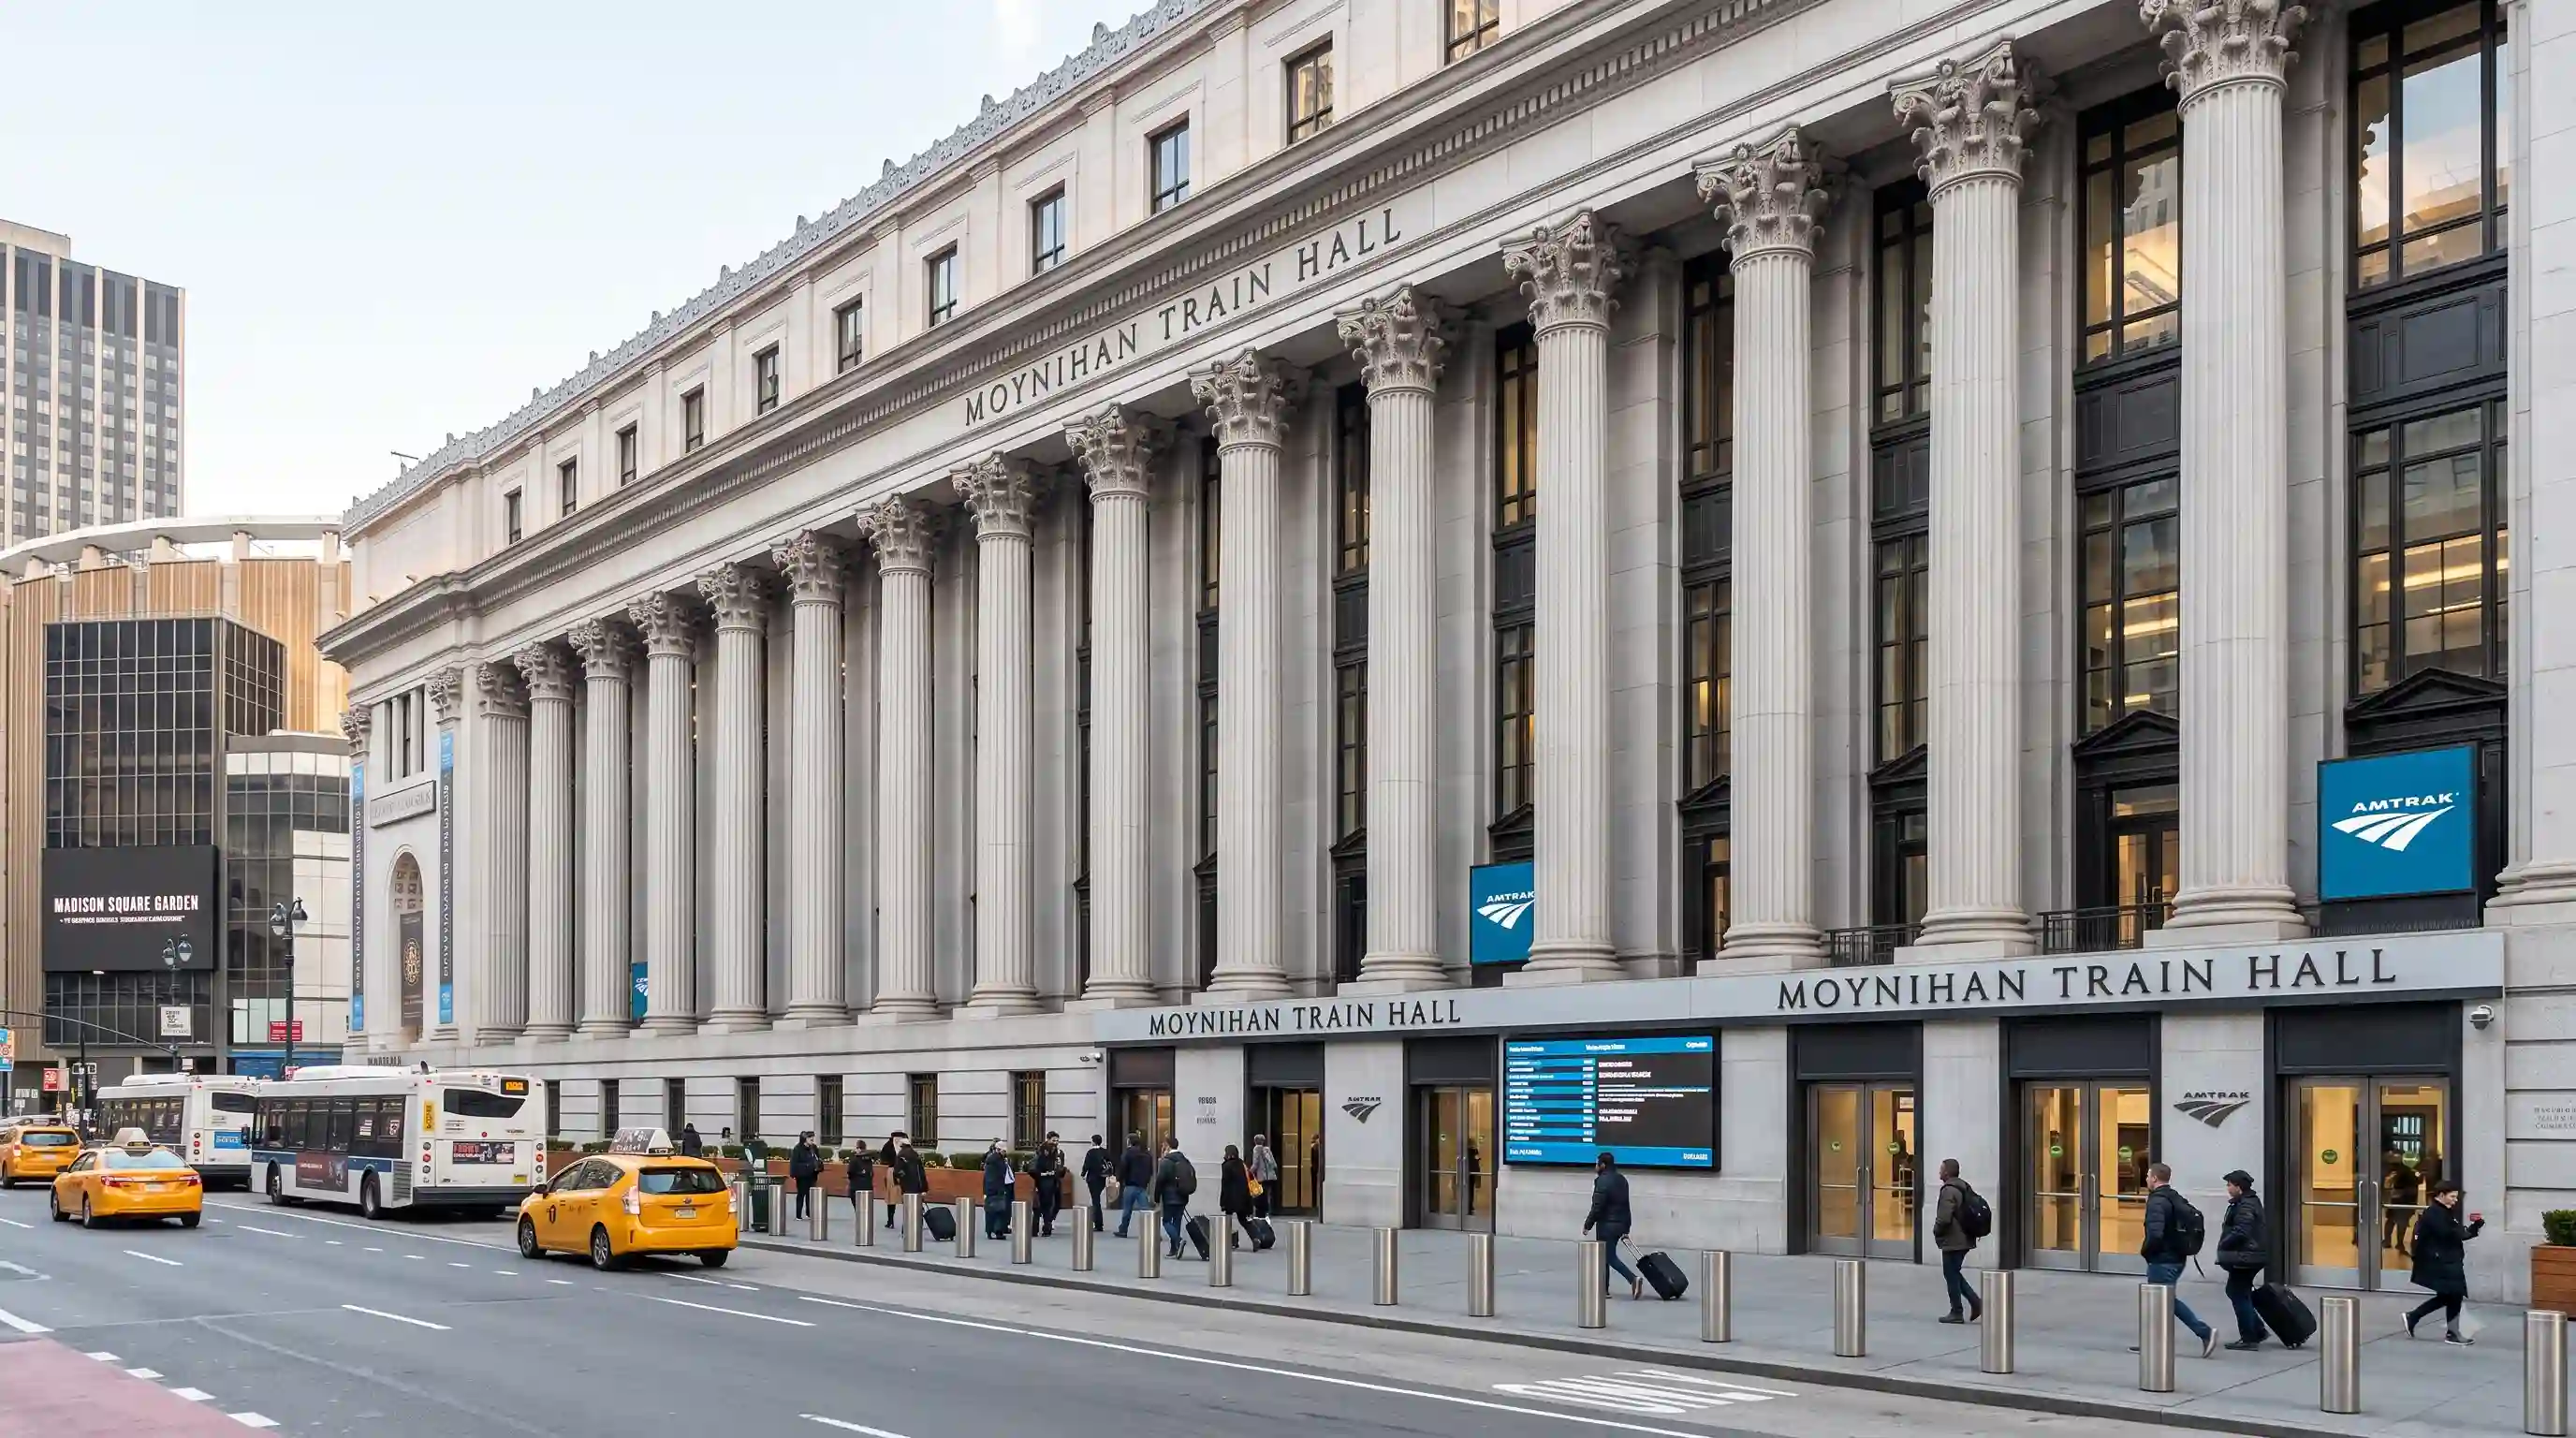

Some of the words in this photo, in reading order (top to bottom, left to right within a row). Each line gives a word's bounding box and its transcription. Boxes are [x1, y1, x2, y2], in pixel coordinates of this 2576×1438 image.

[965, 323, 1137, 427] MOYNIHAN
[1158, 263, 1271, 342] TRAIN
[1297, 208, 1401, 281] HALL
[2351, 792, 2453, 814] AMTRAK
[53, 897, 105, 913] MADISON
[108, 896, 151, 914] SQUARE
[154, 895, 198, 911] GARDEN
[1486, 891, 1535, 902] AMTRAK
[1778, 969, 2026, 1009] MOYNIHAN
[2053, 958, 2214, 998] TRAIN
[2248, 948, 2397, 990] HALL
[1149, 1008, 1280, 1035] MOYNIHAN
[1293, 1004, 1374, 1029] TRAIN
[1389, 1000, 1461, 1026] HALL
